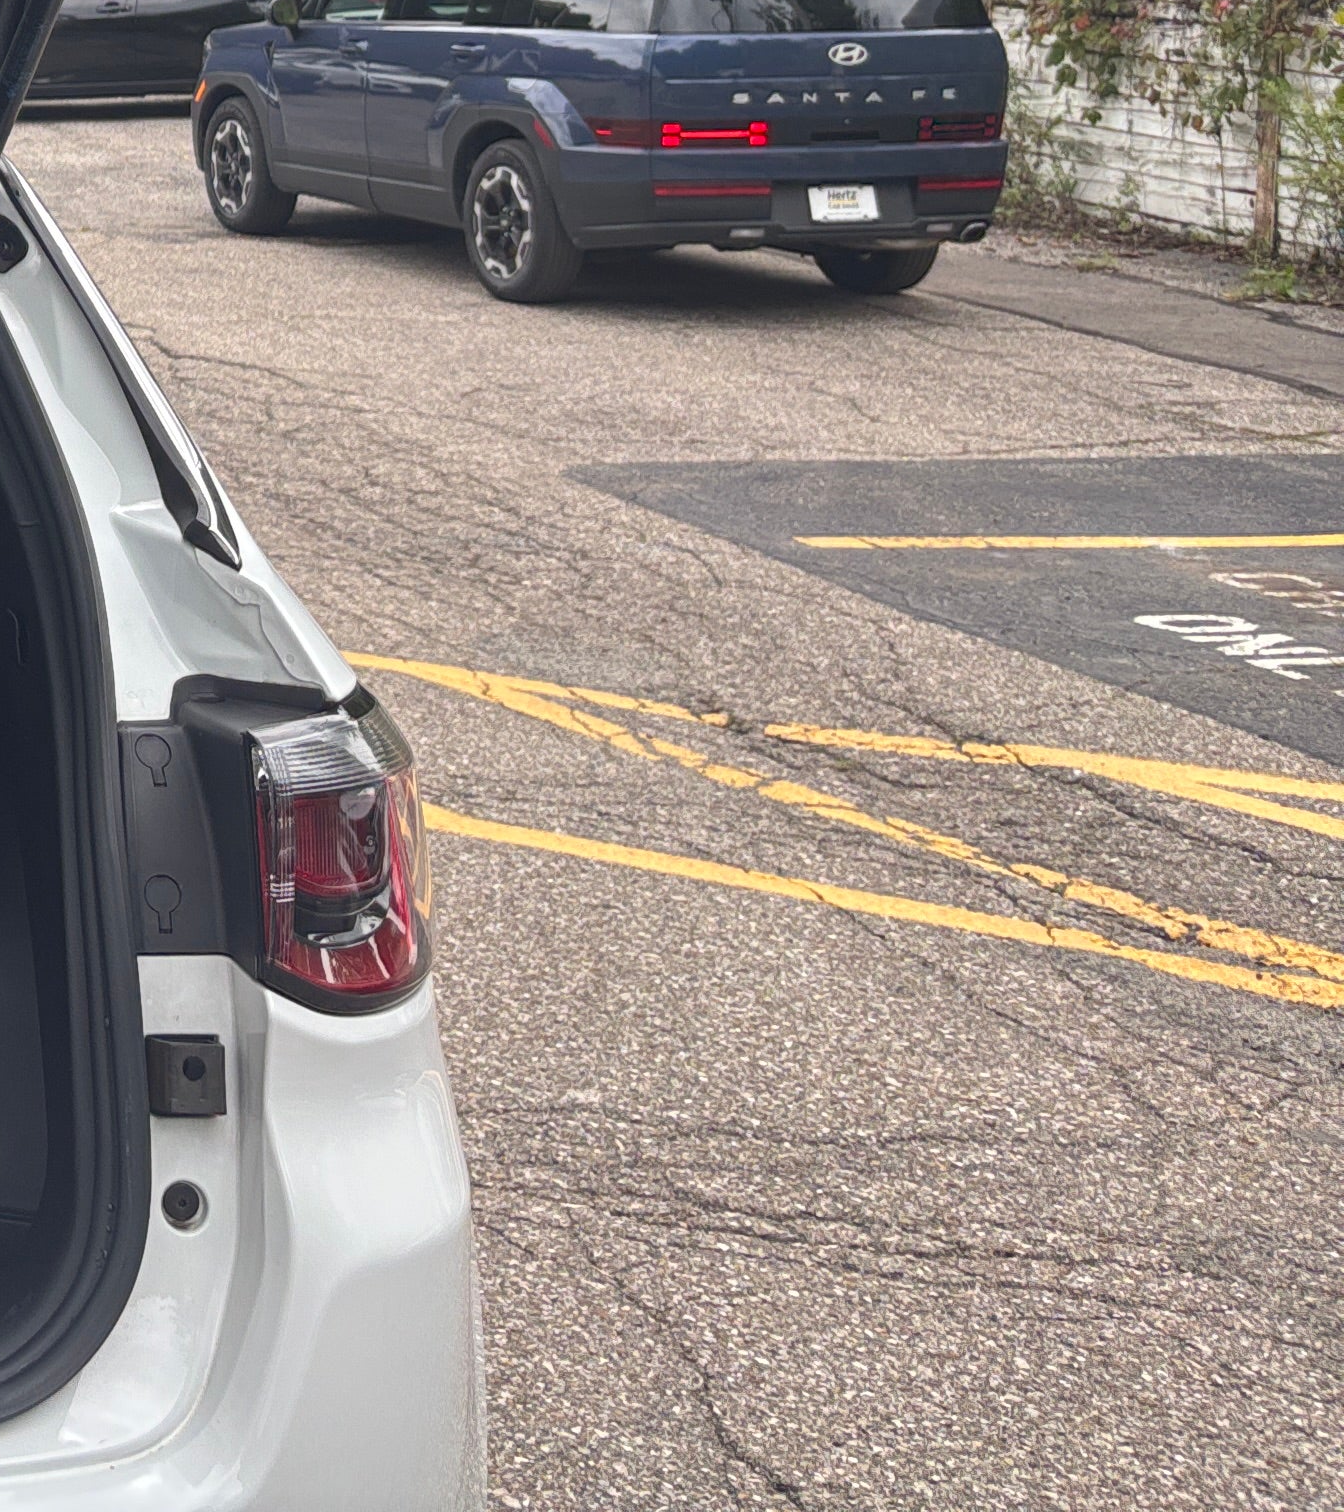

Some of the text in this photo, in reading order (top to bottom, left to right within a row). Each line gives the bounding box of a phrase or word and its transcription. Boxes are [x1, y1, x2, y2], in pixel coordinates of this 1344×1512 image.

[732, 88, 957, 104] SANTA FE
[827, 189, 858, 201] Hertz
[1133, 614, 1344, 697] ONL
